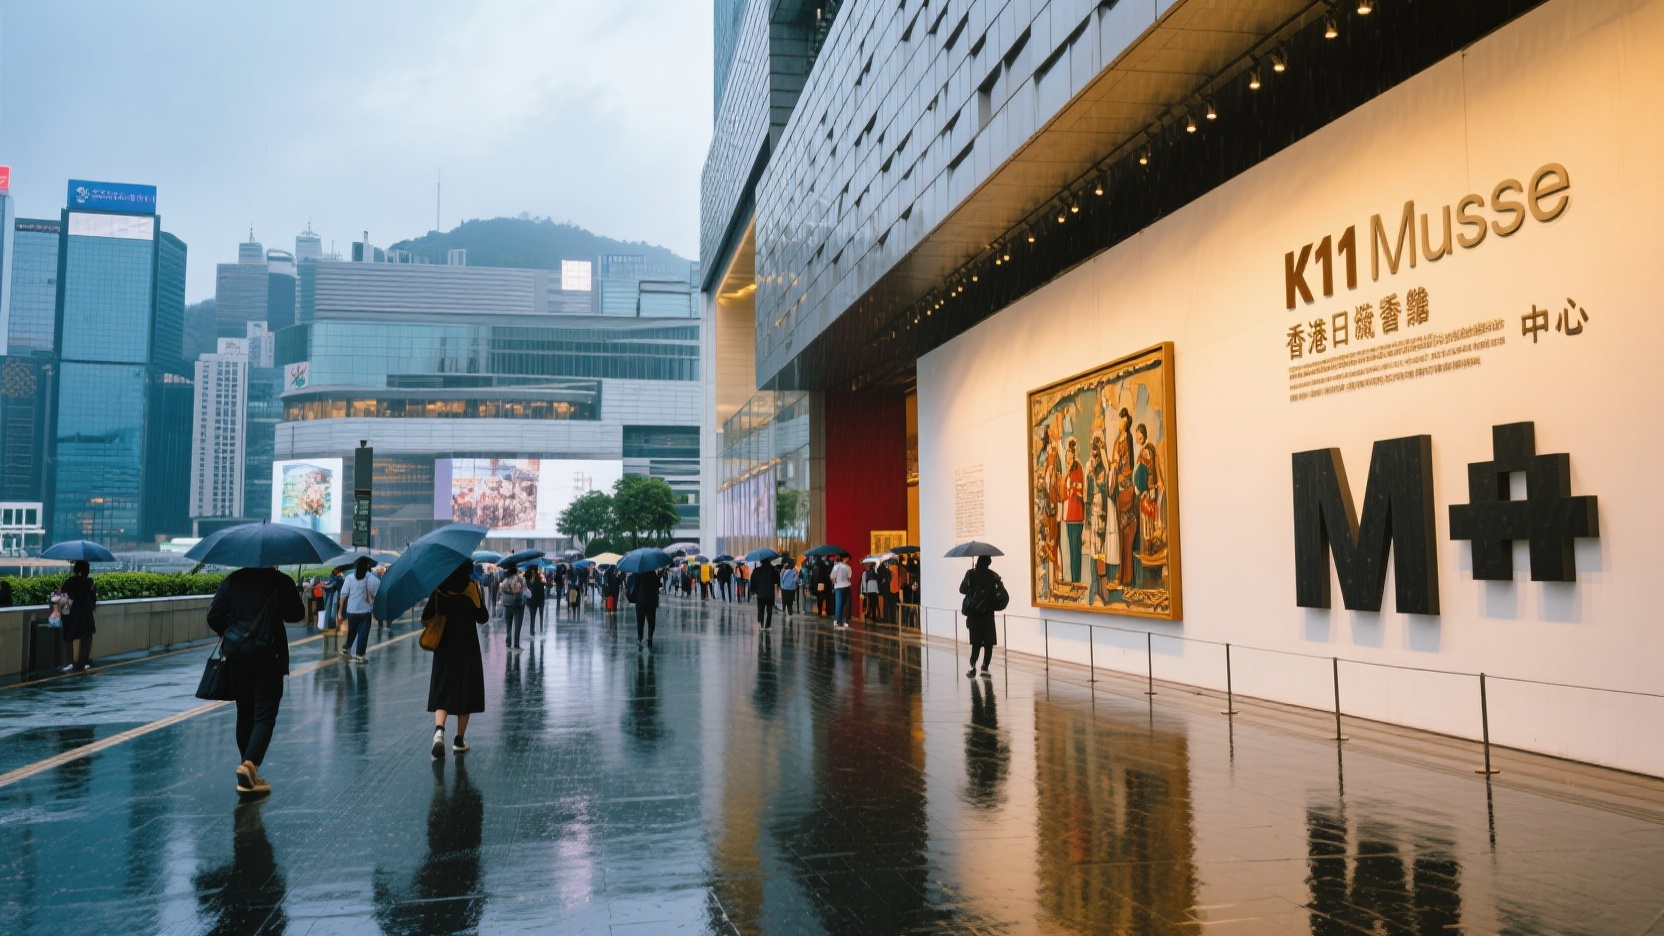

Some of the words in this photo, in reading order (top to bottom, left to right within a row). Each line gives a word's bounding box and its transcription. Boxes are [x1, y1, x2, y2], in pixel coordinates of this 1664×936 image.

[1285, 225, 1357, 310] K11
[1370, 162, 1571, 282] Musse
[1521, 297, 1589, 343] 中心
